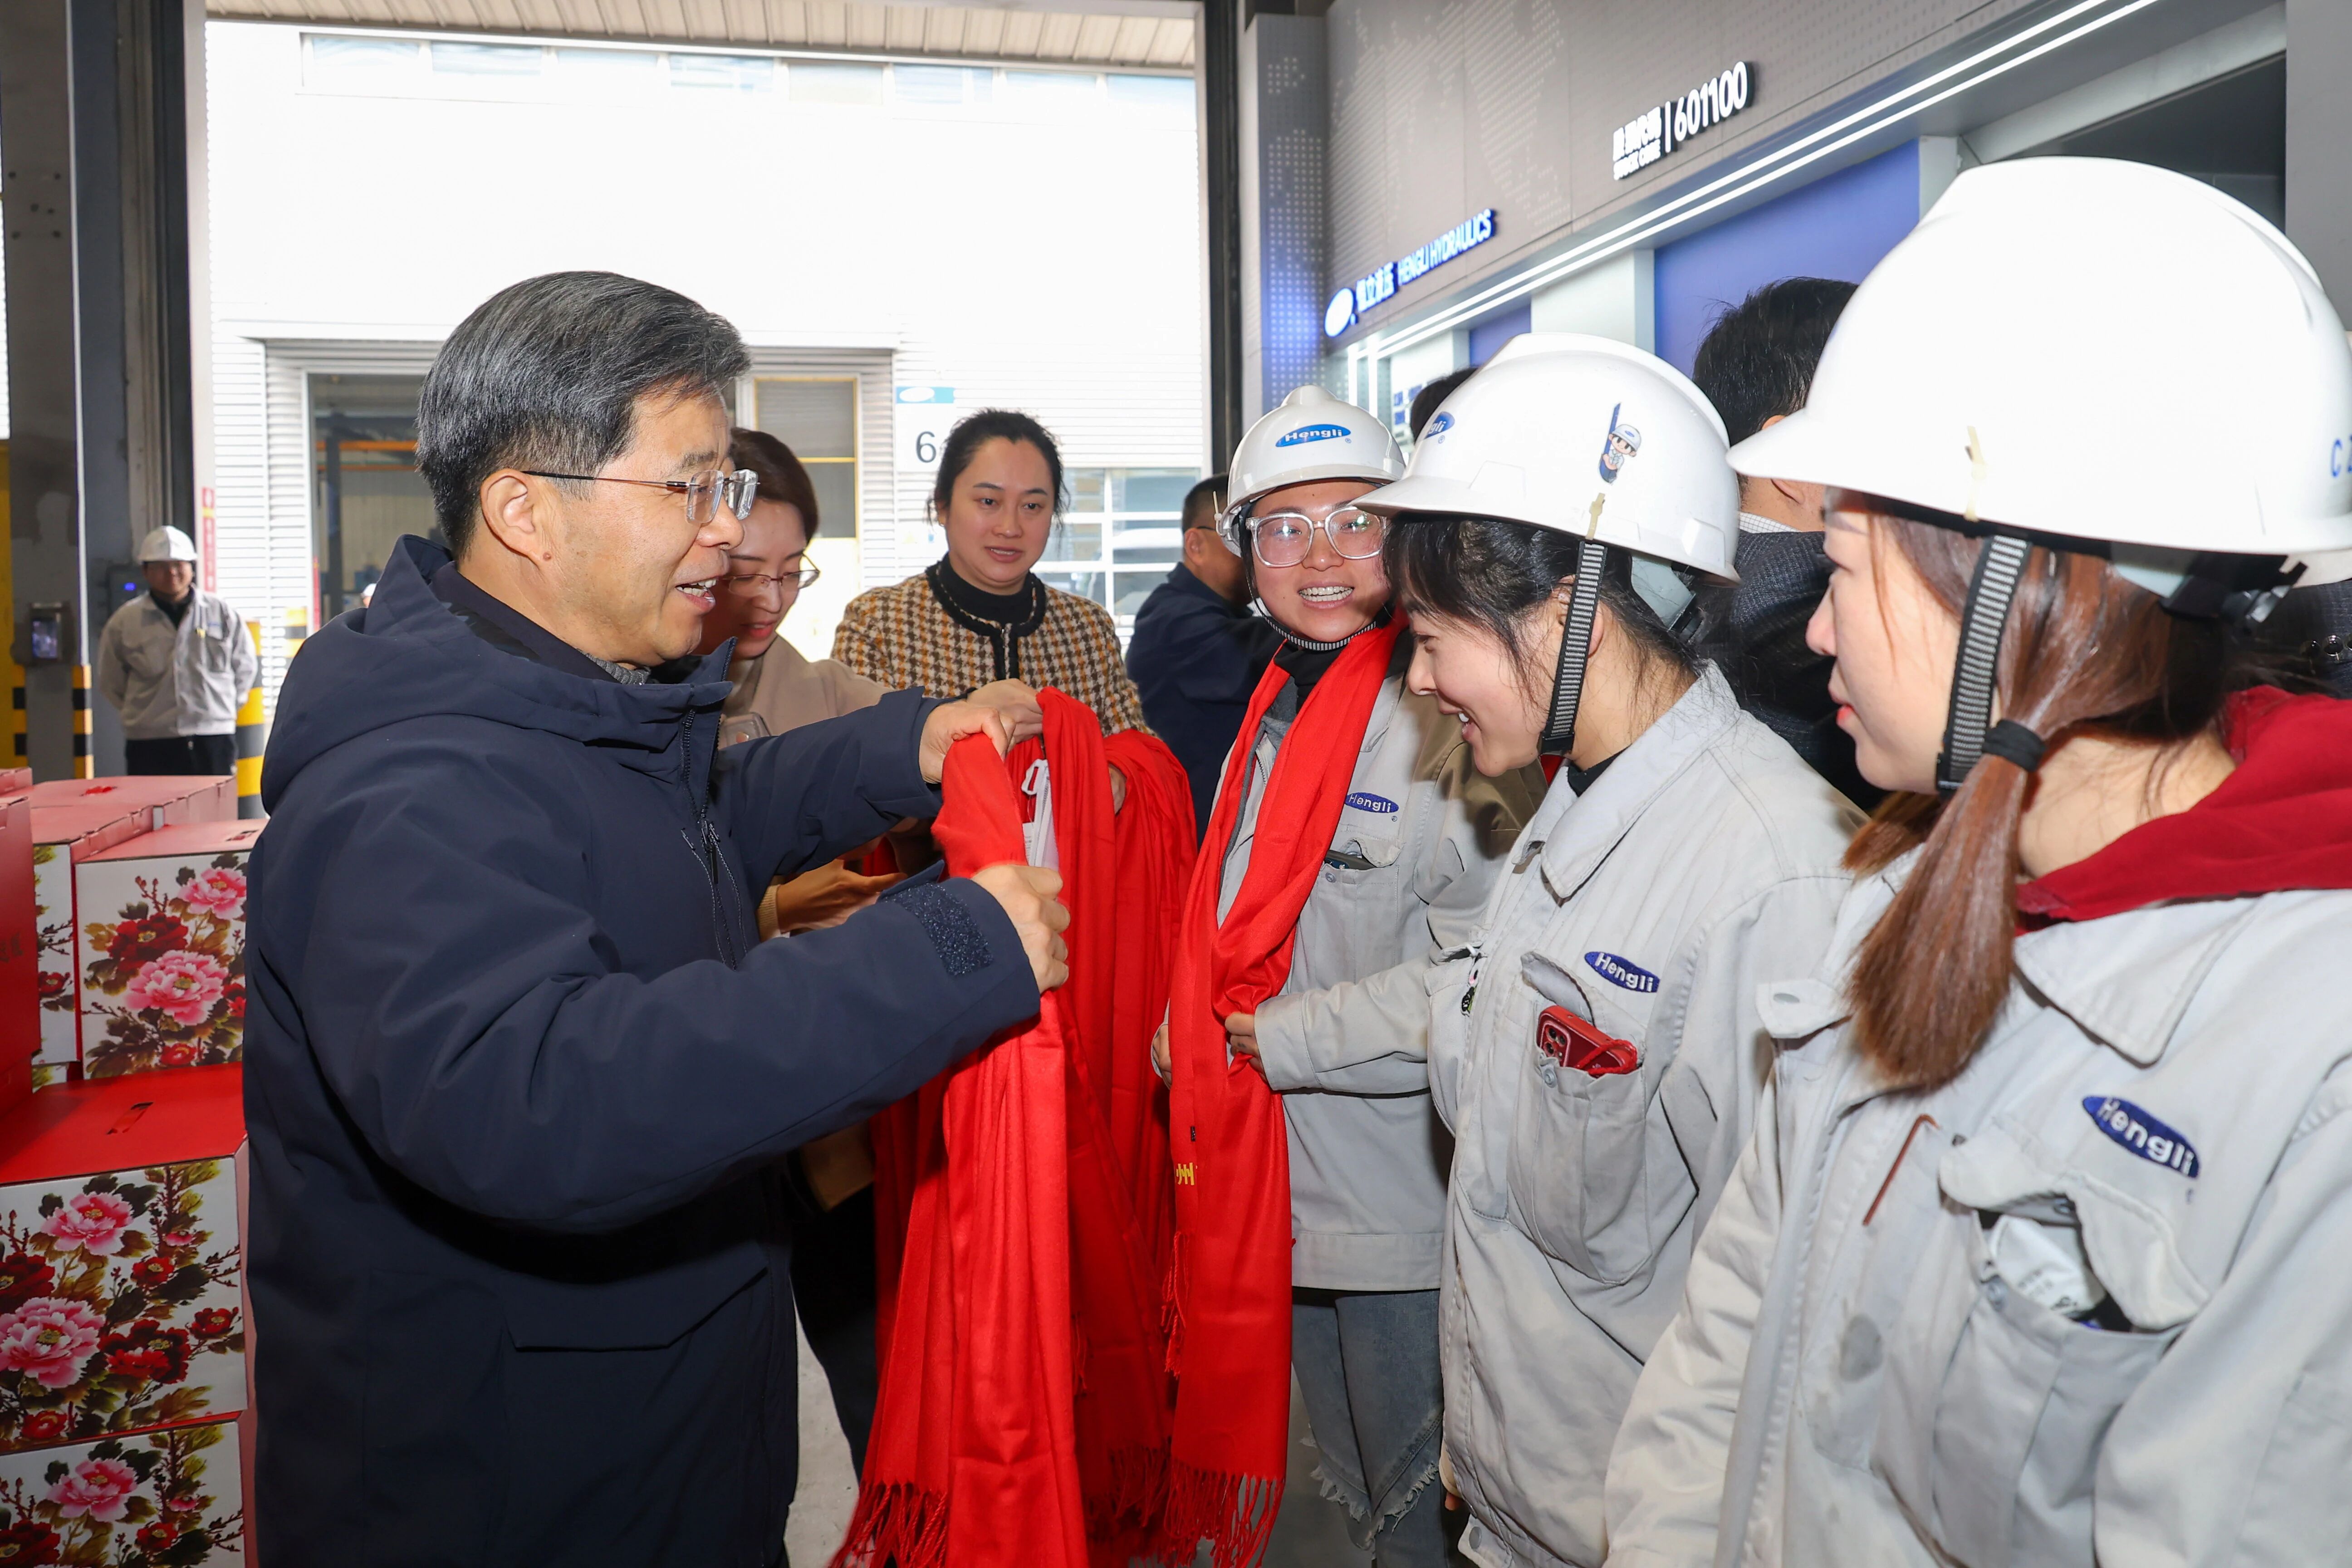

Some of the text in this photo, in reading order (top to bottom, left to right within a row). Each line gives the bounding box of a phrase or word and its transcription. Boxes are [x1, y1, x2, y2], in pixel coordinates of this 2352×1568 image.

[1674, 61, 1748, 142] 601100
[1397, 245, 1430, 286] HENGLI
[1430, 208, 1492, 269] HYDRAULICS
[1285, 429, 1342, 442] Hengli
[1348, 794, 1392, 813] Hengli
[1595, 952, 1654, 992] Hengli
[2097, 1097, 2195, 1176] Hengli
